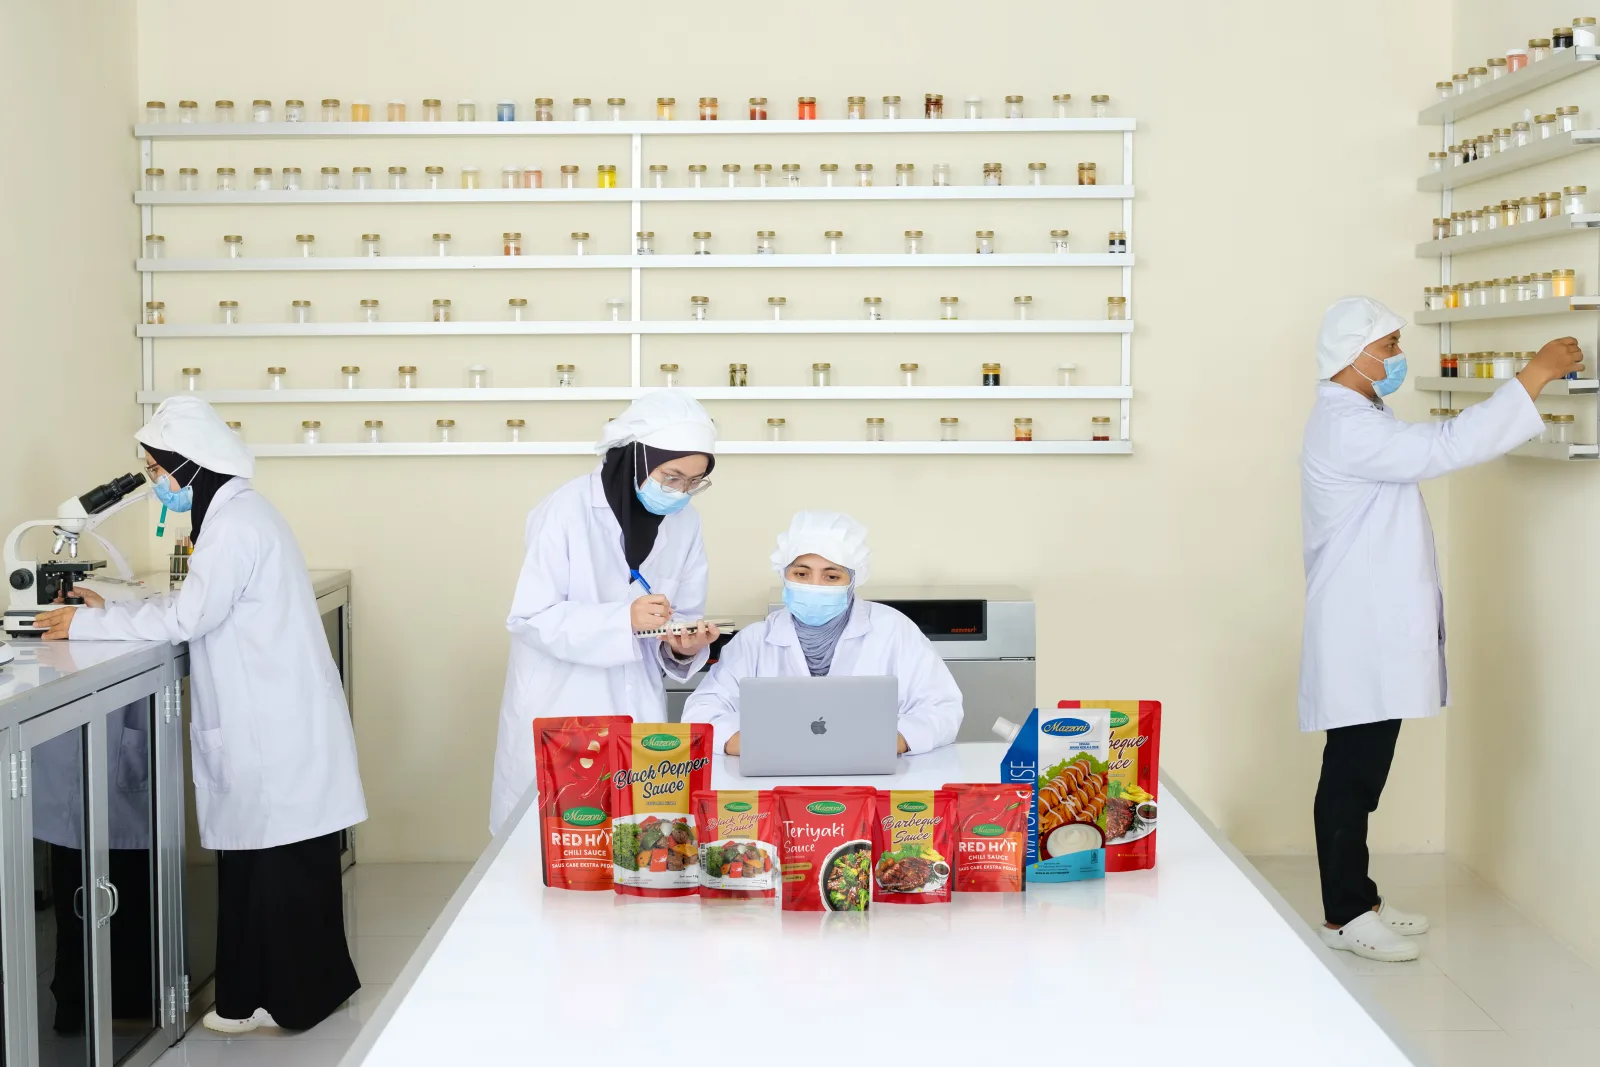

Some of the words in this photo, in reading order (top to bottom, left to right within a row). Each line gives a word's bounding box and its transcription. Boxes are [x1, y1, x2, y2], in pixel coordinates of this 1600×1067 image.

[1043, 720, 1088, 733] Mazzoni
[642, 736, 679, 747] Mazzoni
[1108, 730, 1149, 759] beque
[1108, 759, 1134, 771] uce
[613, 764, 657, 789] Black
[657, 757, 709, 778] Pepper
[642, 780, 685, 799] Sauce
[563, 809, 605, 822] Mazzoni
[881, 812, 944, 834] Barbeque
[705, 815, 736, 832] Black
[721, 823, 754, 836] Sauce
[782, 820, 845, 842] Teriyaki
[551, 832, 582, 847] RED
[892, 829, 931, 844] Sauce
[563, 849, 582, 857] CHILI
[583, 849, 607, 857] SAUCE
[783, 839, 816, 853] Sauce
[958, 841, 986, 853] RED
[988, 838, 1018, 853] HOT
